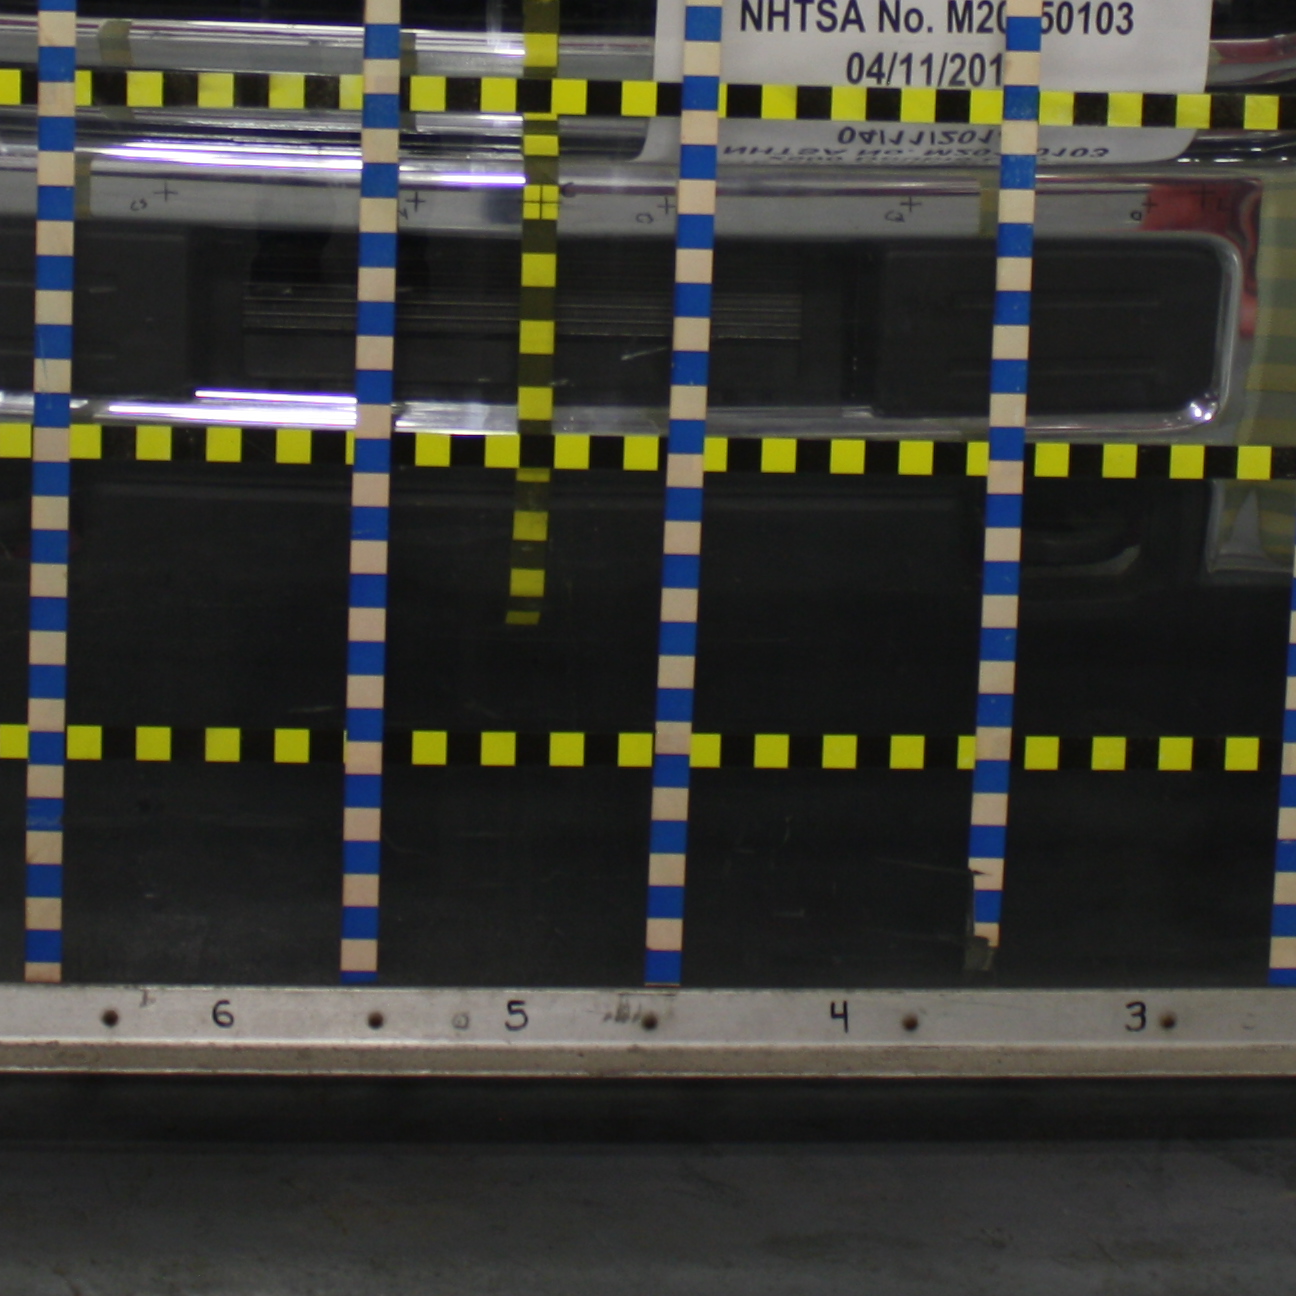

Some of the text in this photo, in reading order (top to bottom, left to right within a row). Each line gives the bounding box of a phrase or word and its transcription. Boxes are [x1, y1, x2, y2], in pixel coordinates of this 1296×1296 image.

[878, 0, 934, 34] No.
[946, 0, 1135, 36] M2050103
[845, 52, 1004, 88] 04/11/201
[211, 999, 236, 1030] 6
[504, 1000, 530, 1032] 5
[829, 1000, 850, 1034] 4
[1124, 1001, 1148, 1033] 3
